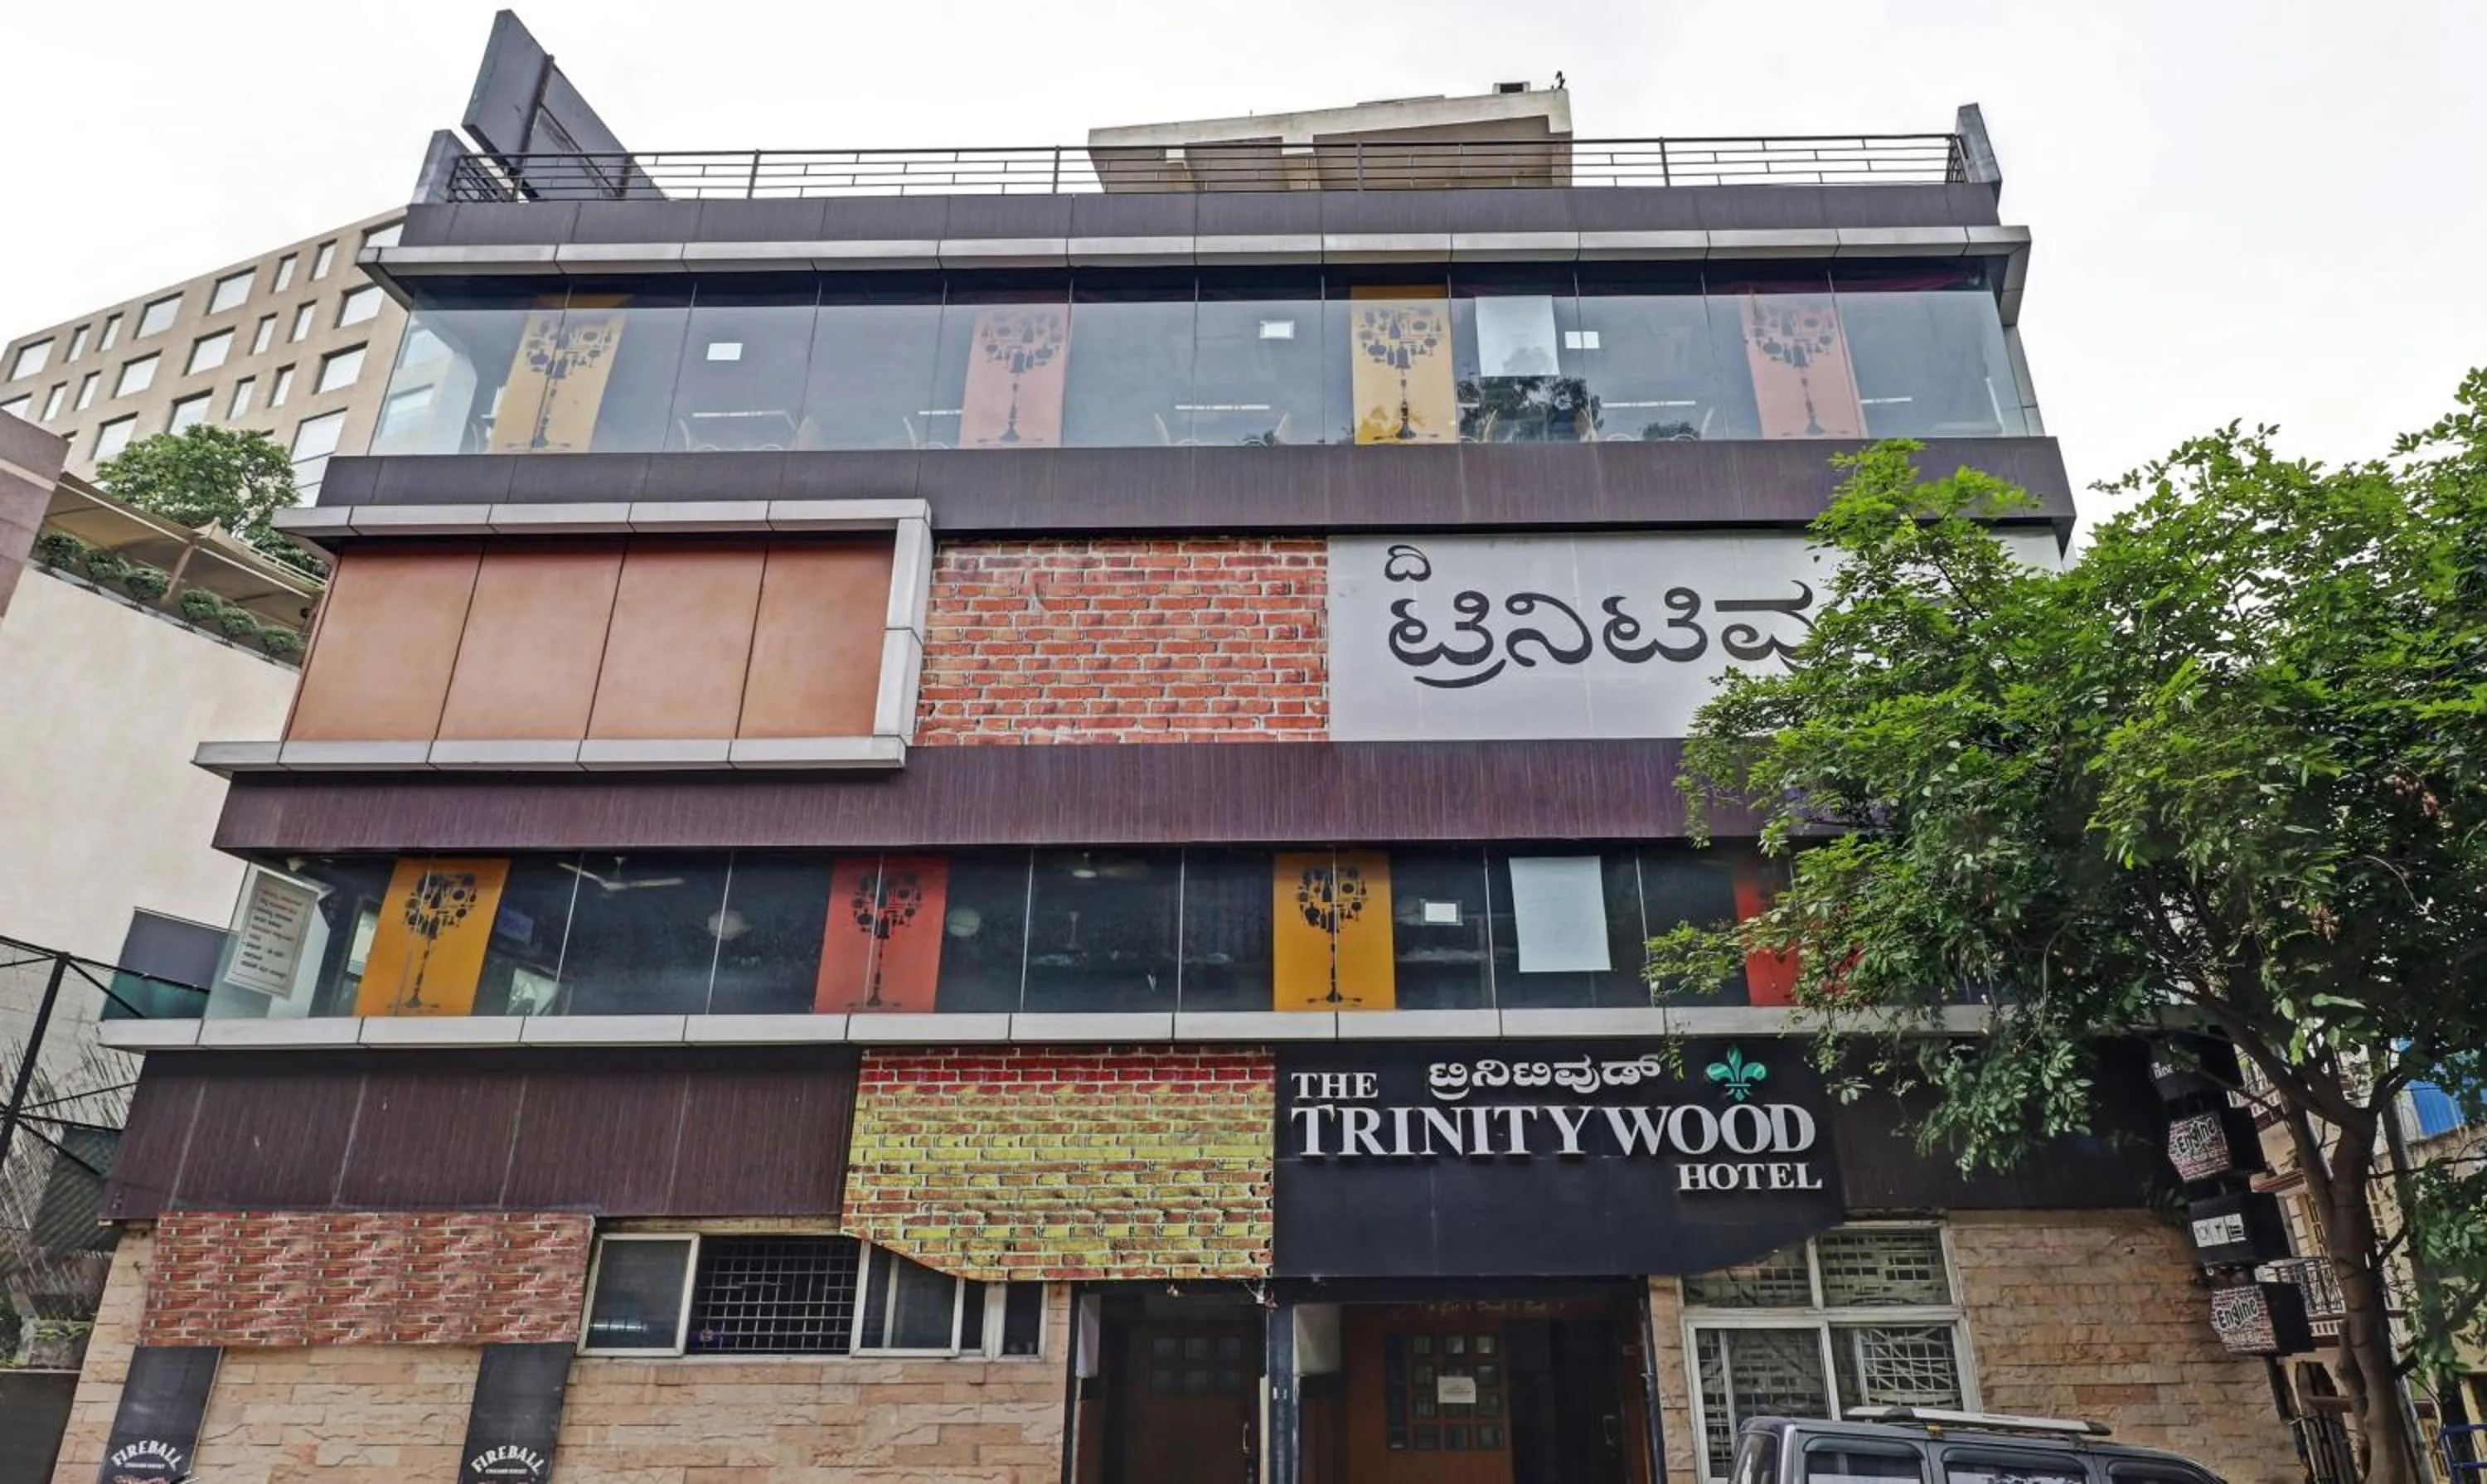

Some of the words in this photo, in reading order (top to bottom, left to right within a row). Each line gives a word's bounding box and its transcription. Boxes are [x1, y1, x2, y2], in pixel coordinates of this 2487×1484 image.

[1291, 1072, 1379, 1099] THE
[1677, 1163, 1823, 1191] HOTEL
[110, 1440, 182, 1472] FIREBALL
[470, 1445, 544, 1477] FIREBALL
